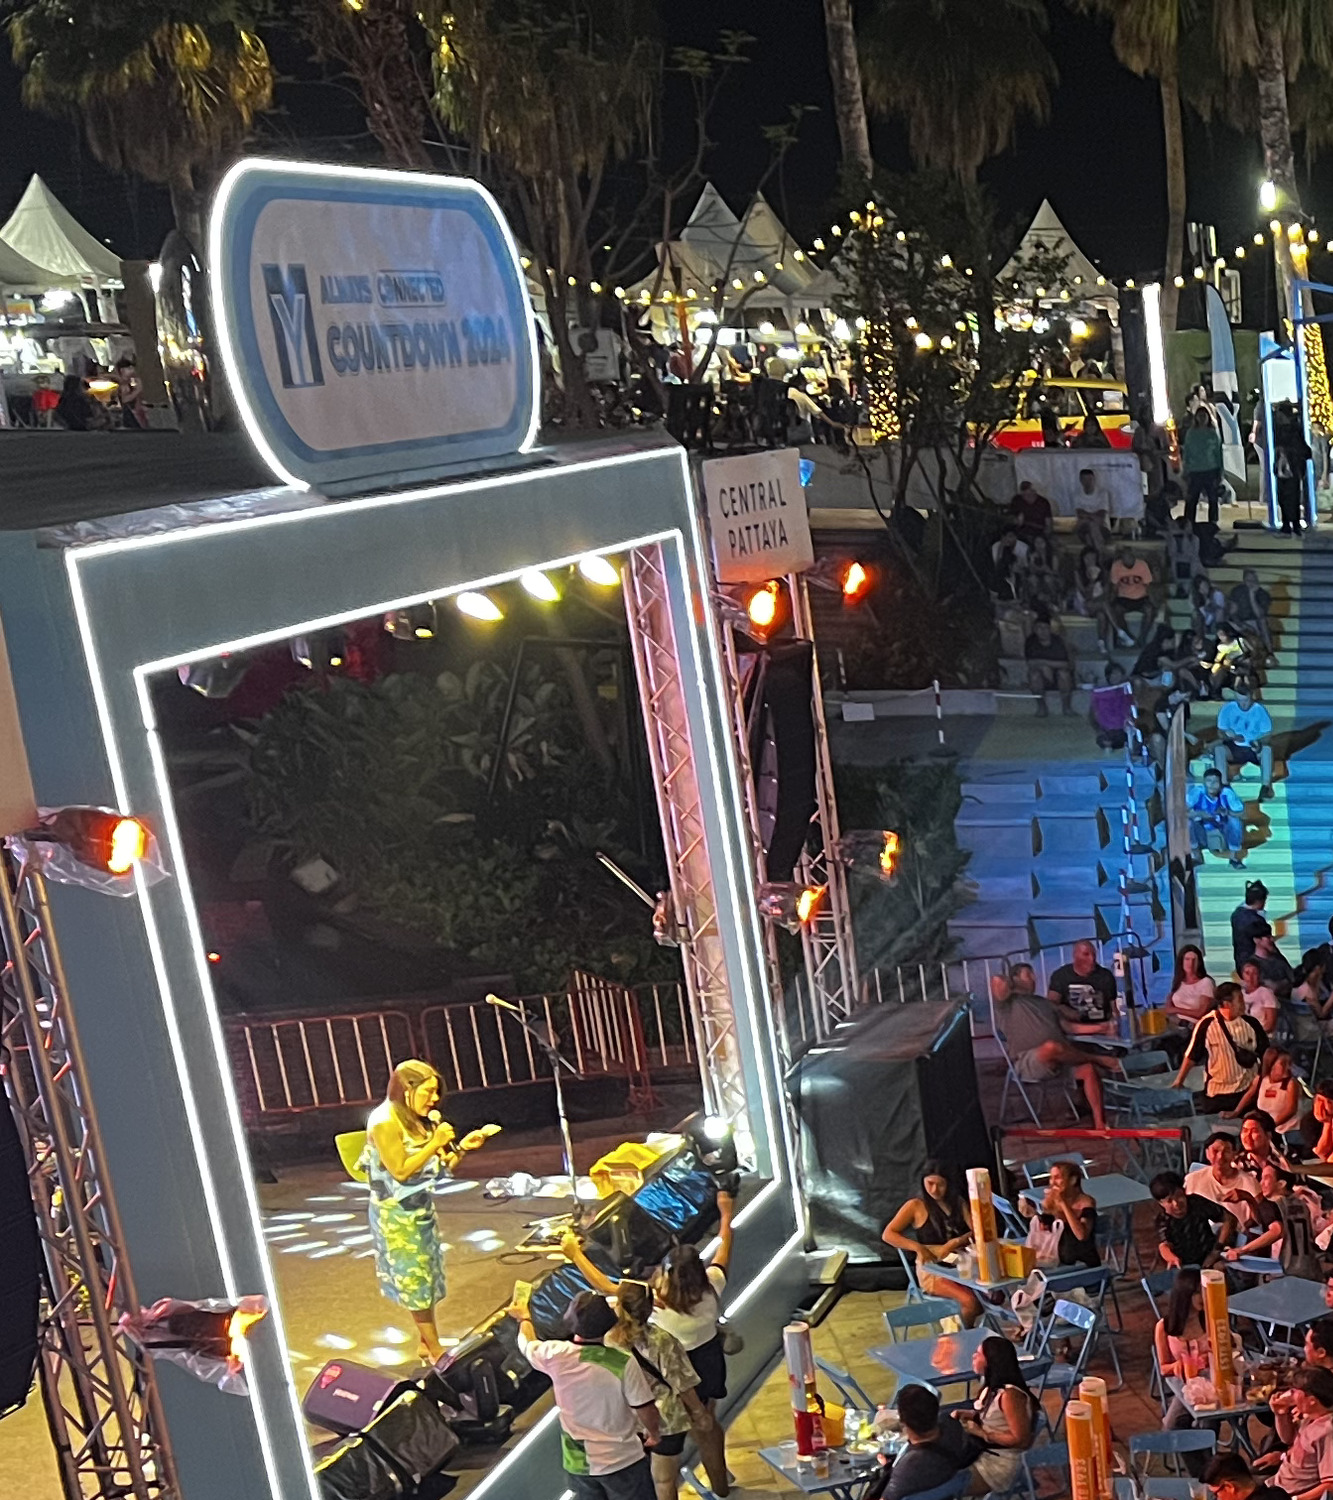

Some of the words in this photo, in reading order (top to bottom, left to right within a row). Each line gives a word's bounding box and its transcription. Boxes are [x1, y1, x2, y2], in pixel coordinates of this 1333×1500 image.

[320, 275, 372, 304] ALWAYS
[379, 271, 445, 304] CONNECTED
[326, 321, 462, 377] COUNTDOWN
[460, 313, 511, 367] 2024
[719, 478, 787, 518] CENTRAL
[728, 517, 789, 558] PATTAYA
